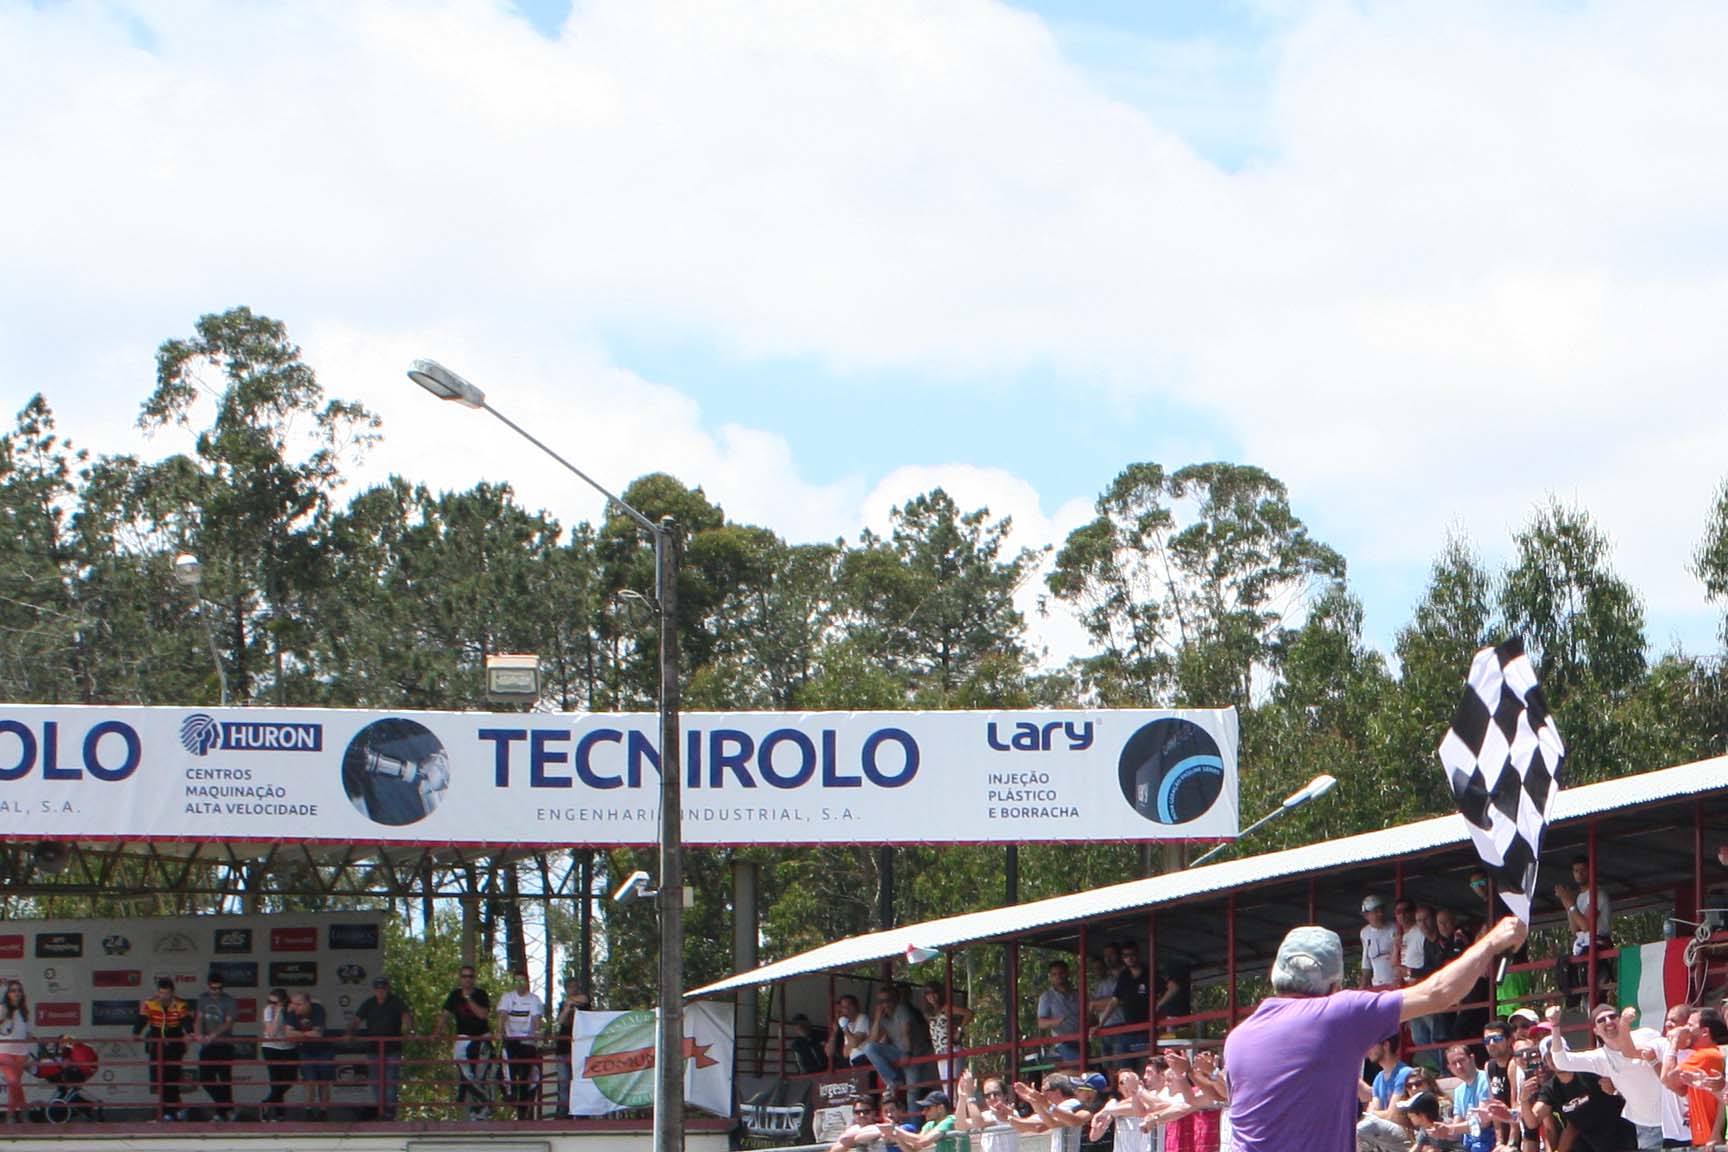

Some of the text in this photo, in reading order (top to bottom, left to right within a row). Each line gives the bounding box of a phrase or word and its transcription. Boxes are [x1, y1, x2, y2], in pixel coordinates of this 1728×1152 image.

[231, 725, 315, 748] HURON
[478, 728, 920, 789] TECNIROLO
[185, 768, 252, 781] CENTROS
[988, 770, 1049, 787] INJEÇÃO
[185, 784, 286, 801] MAQUINAÇÃO
[988, 787, 1057, 801] PLÁSTICO
[185, 802, 318, 816] ALTA VELOCIDADE
[536, 808, 656, 821] ENGENHARI
[821, 808, 861, 820] S.A.
[988, 806, 1079, 818] E BORRACHA
